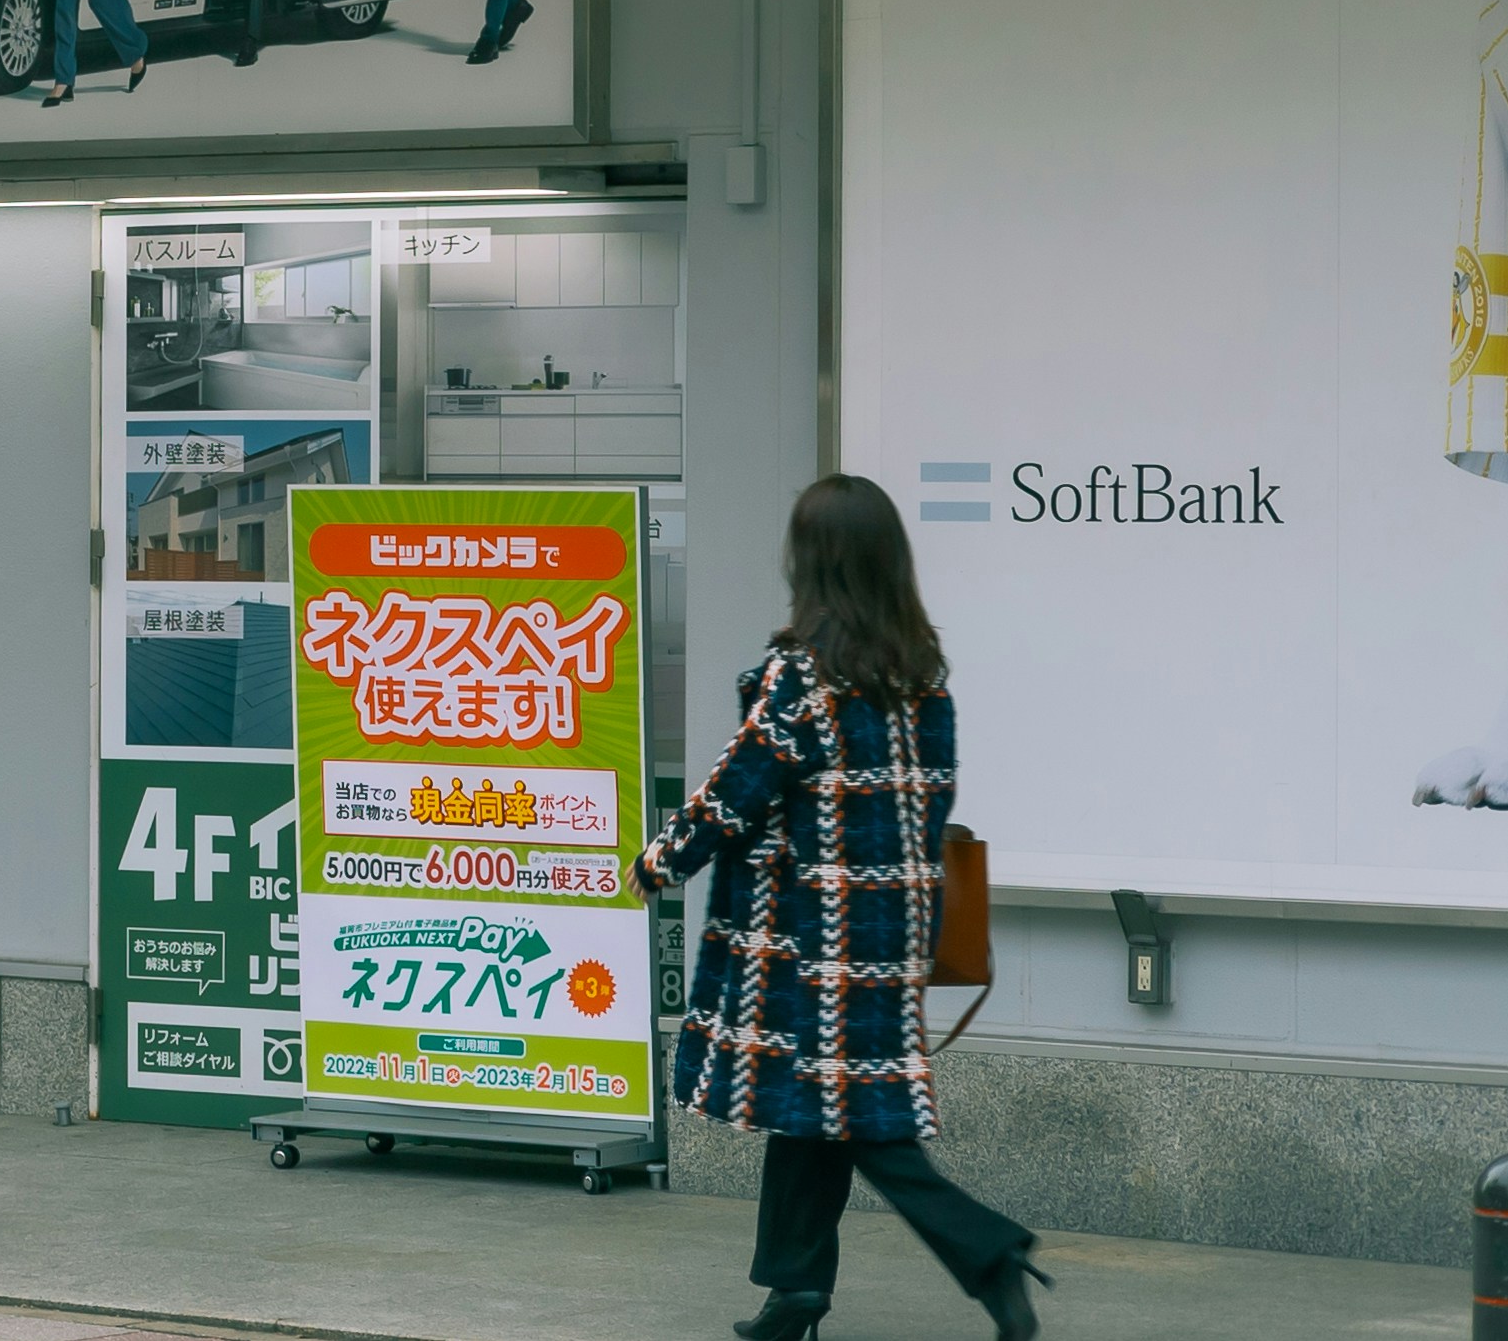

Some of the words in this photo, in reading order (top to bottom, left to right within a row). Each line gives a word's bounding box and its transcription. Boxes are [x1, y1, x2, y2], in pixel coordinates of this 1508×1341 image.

[134, 238, 236, 262] バスルーム
[404, 233, 481, 258] キッチン
[143, 442, 226, 466] 外壁塗装
[1010, 461, 1284, 525] SoftBank
[370, 534, 561, 569] ビックカメラで
[142, 609, 226, 632] 屋根塗装
[307, 595, 619, 685] ネクスペイ
[363, 675, 569, 731] 使えます!
[335, 782, 397, 802] 当店での
[410, 776, 537, 829] 現金同率
[540, 795, 597, 812] ポイント
[335, 803, 408, 822] お買物なら
[540, 813, 607, 831] サービス!
[118, 786, 237, 903] 4F
[133, 936, 218, 957] おうちのお悩み
[342, 932, 412, 950] FUKUOKA
[416, 932, 456, 946] NEXT
[458, 919, 525, 960] Pay
[145, 956, 206, 975] 解決します
[342, 957, 566, 1020] ネクスペイ
[143, 1029, 209, 1048] リフォーム
[442, 1038, 500, 1053] ご利用期間
[142, 1049, 237, 1072] ご相談ダイヤル
